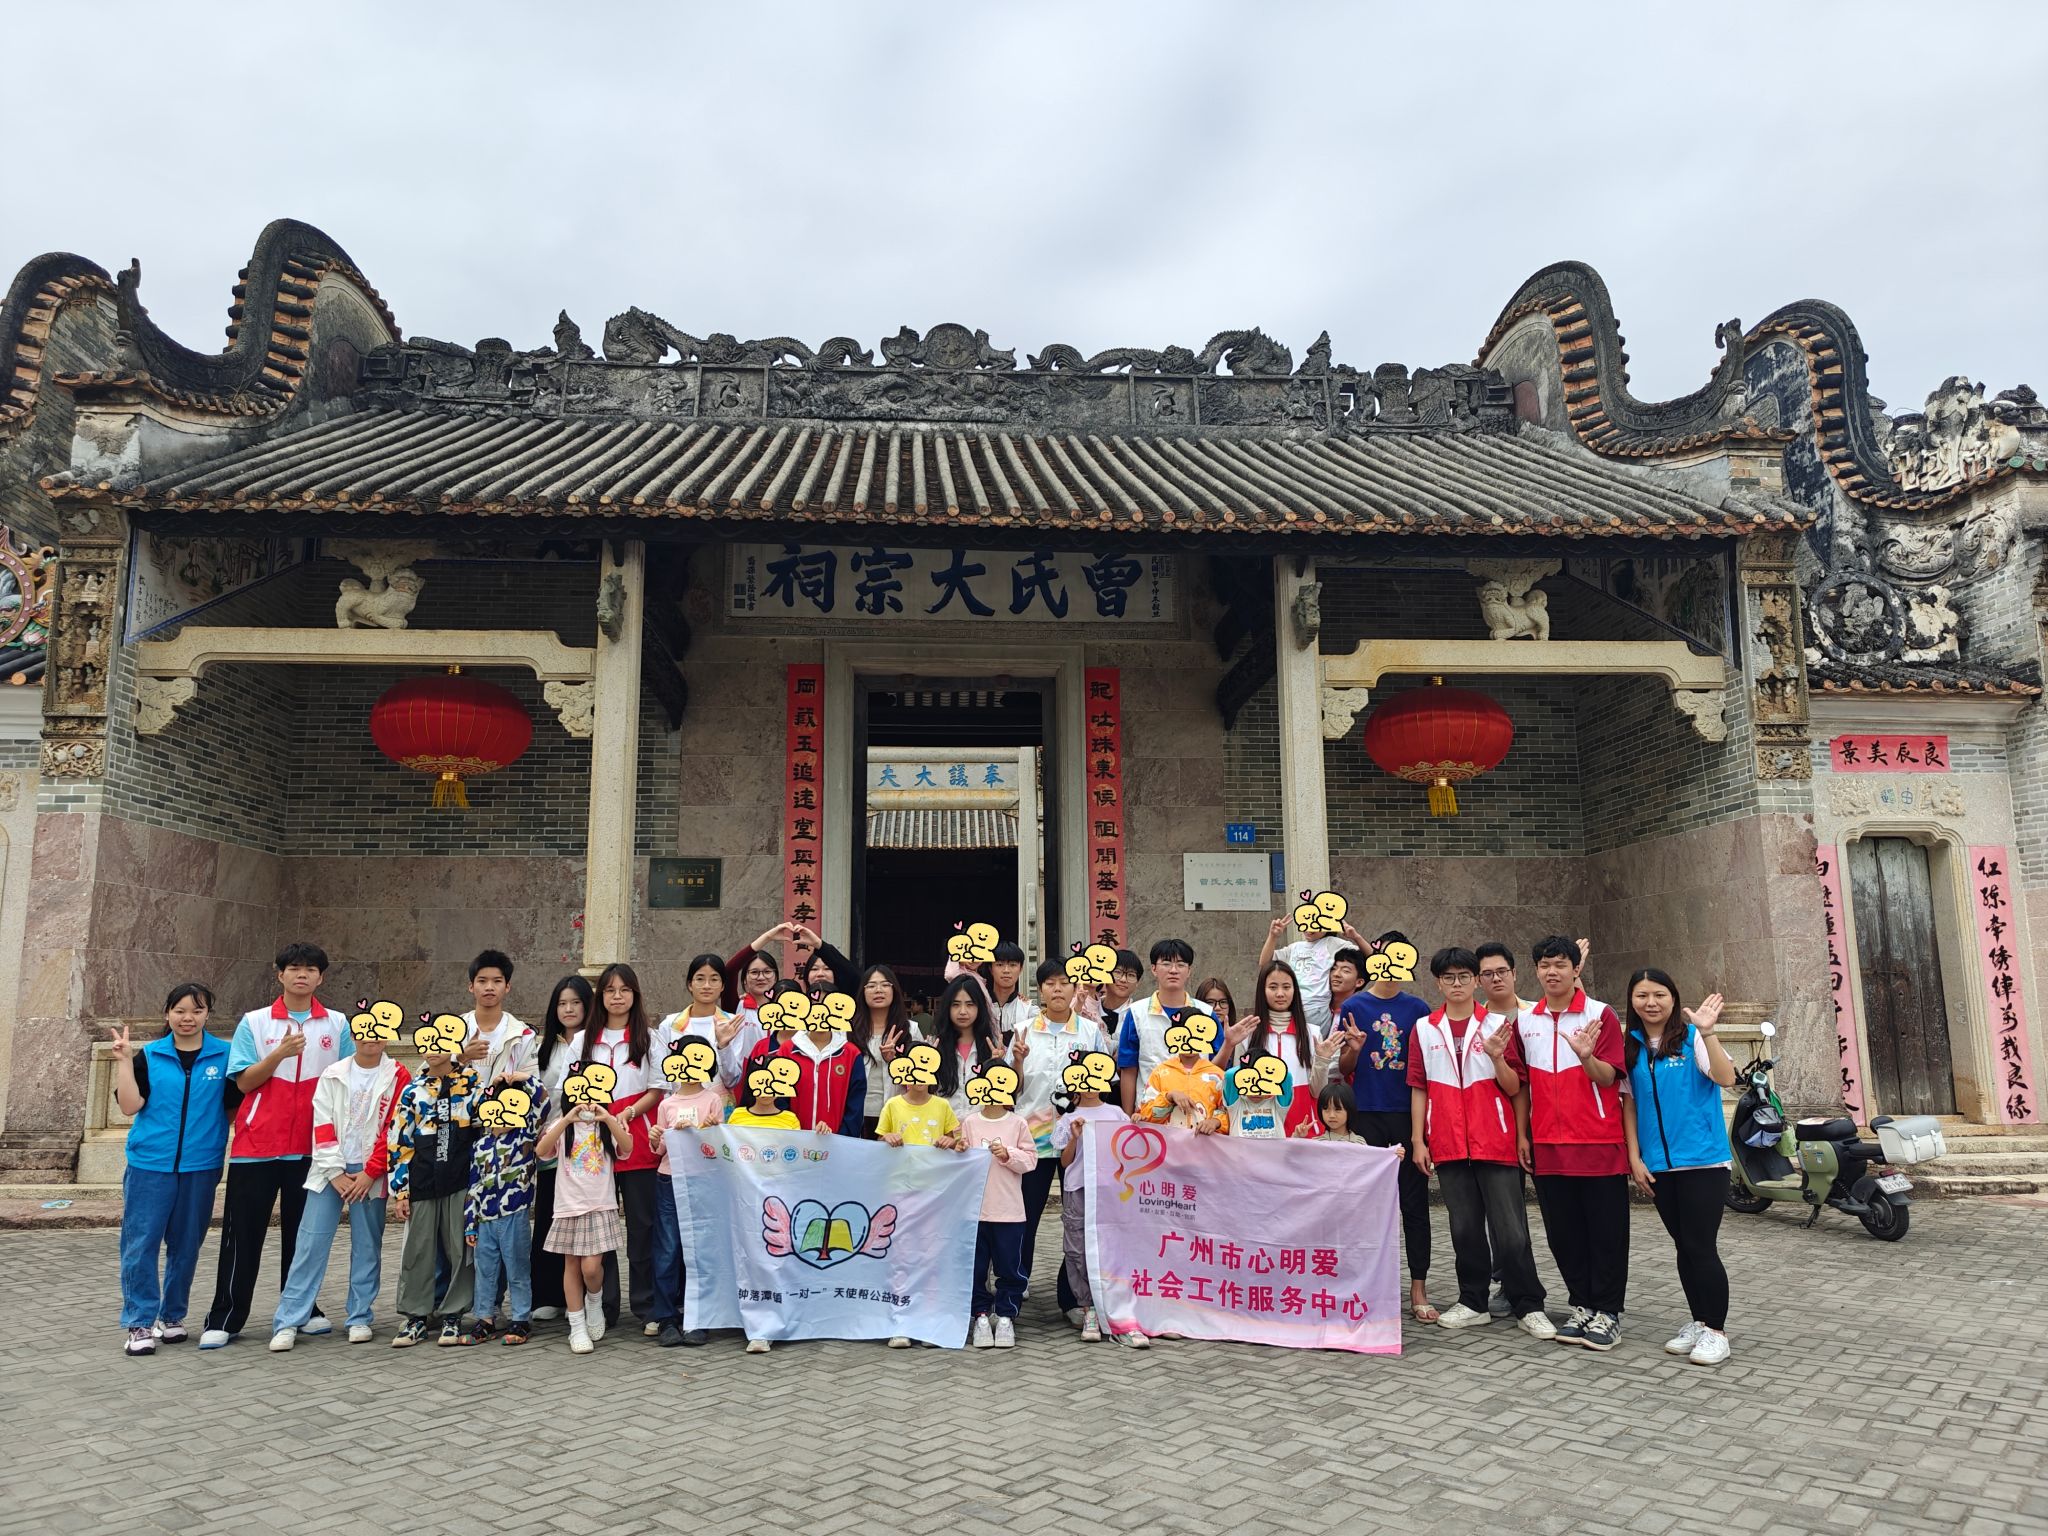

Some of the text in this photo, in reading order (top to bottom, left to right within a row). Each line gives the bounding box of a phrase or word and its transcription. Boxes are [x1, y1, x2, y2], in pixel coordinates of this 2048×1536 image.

[1839, 739, 1945, 767] 良辰美景
[878, 764, 1004, 788] 奉議大夫
[1233, 831, 1249, 841] 114
[1140, 1180, 1197, 1201] 心明爱
[1139, 1196, 1197, 1212] LovingHeart
[1158, 1231, 1339, 1278] 广州市心明爱
[1131, 1268, 1368, 1321] 社会工作服务中心
